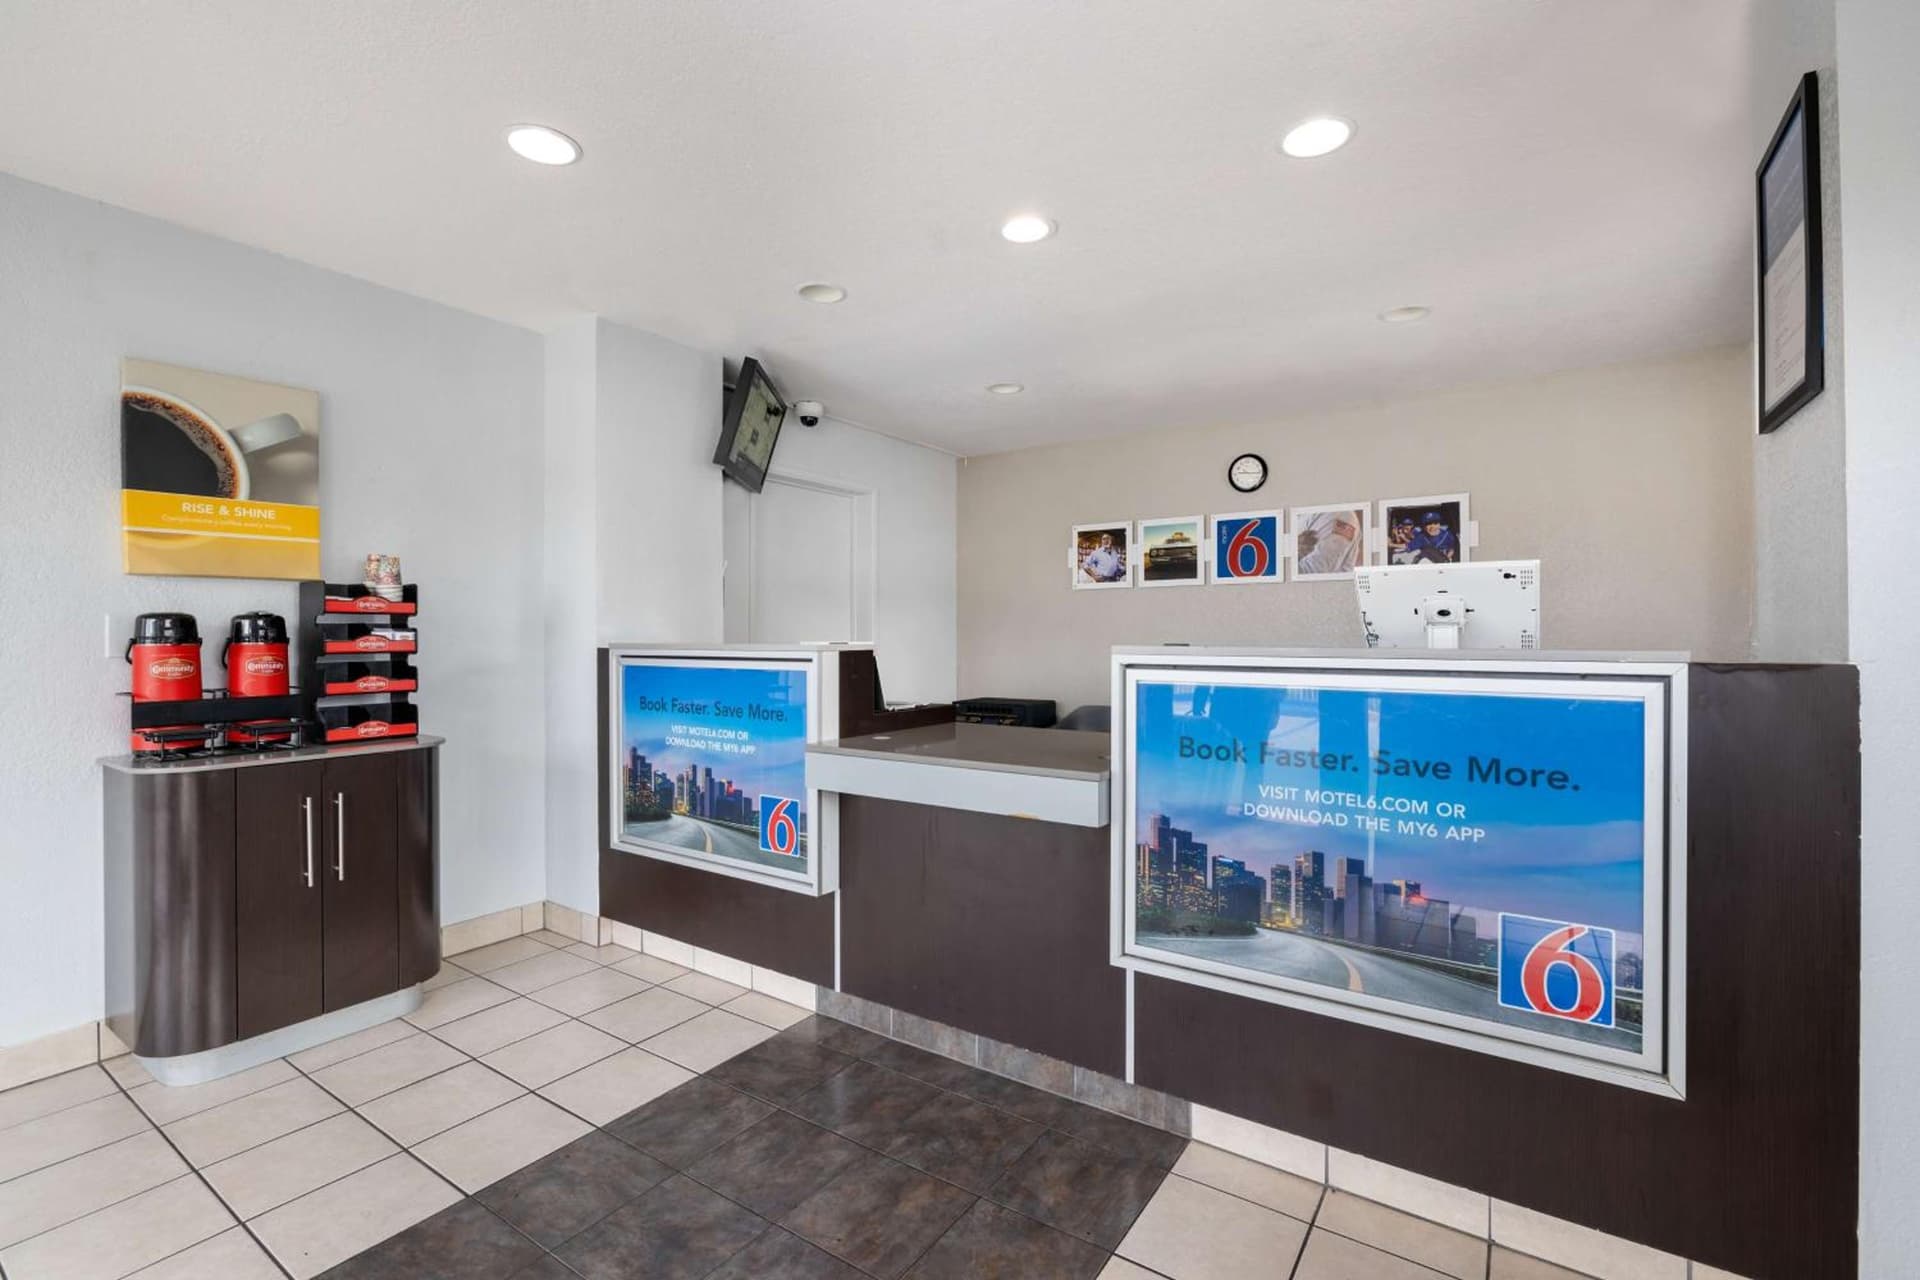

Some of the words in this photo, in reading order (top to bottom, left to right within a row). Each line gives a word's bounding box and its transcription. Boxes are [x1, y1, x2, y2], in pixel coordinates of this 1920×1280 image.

[182, 502, 214, 515] RISE
[218, 504, 230, 516] &
[234, 506, 276, 520] SHINE
[1227, 518, 1269, 578] 6
[639, 696, 667, 713] Book
[672, 698, 710, 716] Faster.
[714, 701, 744, 719] Save
[748, 703, 788, 722] More.
[665, 736, 707, 749] DOWNLOAD
[708, 741, 722, 752] THE
[671, 724, 688, 735] VISIT
[1178, 736, 1248, 764] Book
[1259, 740, 1359, 773] Faster.
[1373, 748, 1453, 781] Save
[1467, 755, 1581, 792] More.
[1258, 784, 1300, 801] VISIT
[1304, 788, 1429, 815] MOTEL6.COM
[1436, 801, 1467, 819] OR
[767, 798, 797, 855] 6
[1243, 802, 1348, 827] DOWNLOAD
[1354, 814, 1391, 832] THE
[1397, 819, 1438, 838] MY6
[1444, 825, 1486, 843] APP
[1520, 924, 1606, 1024] 6
